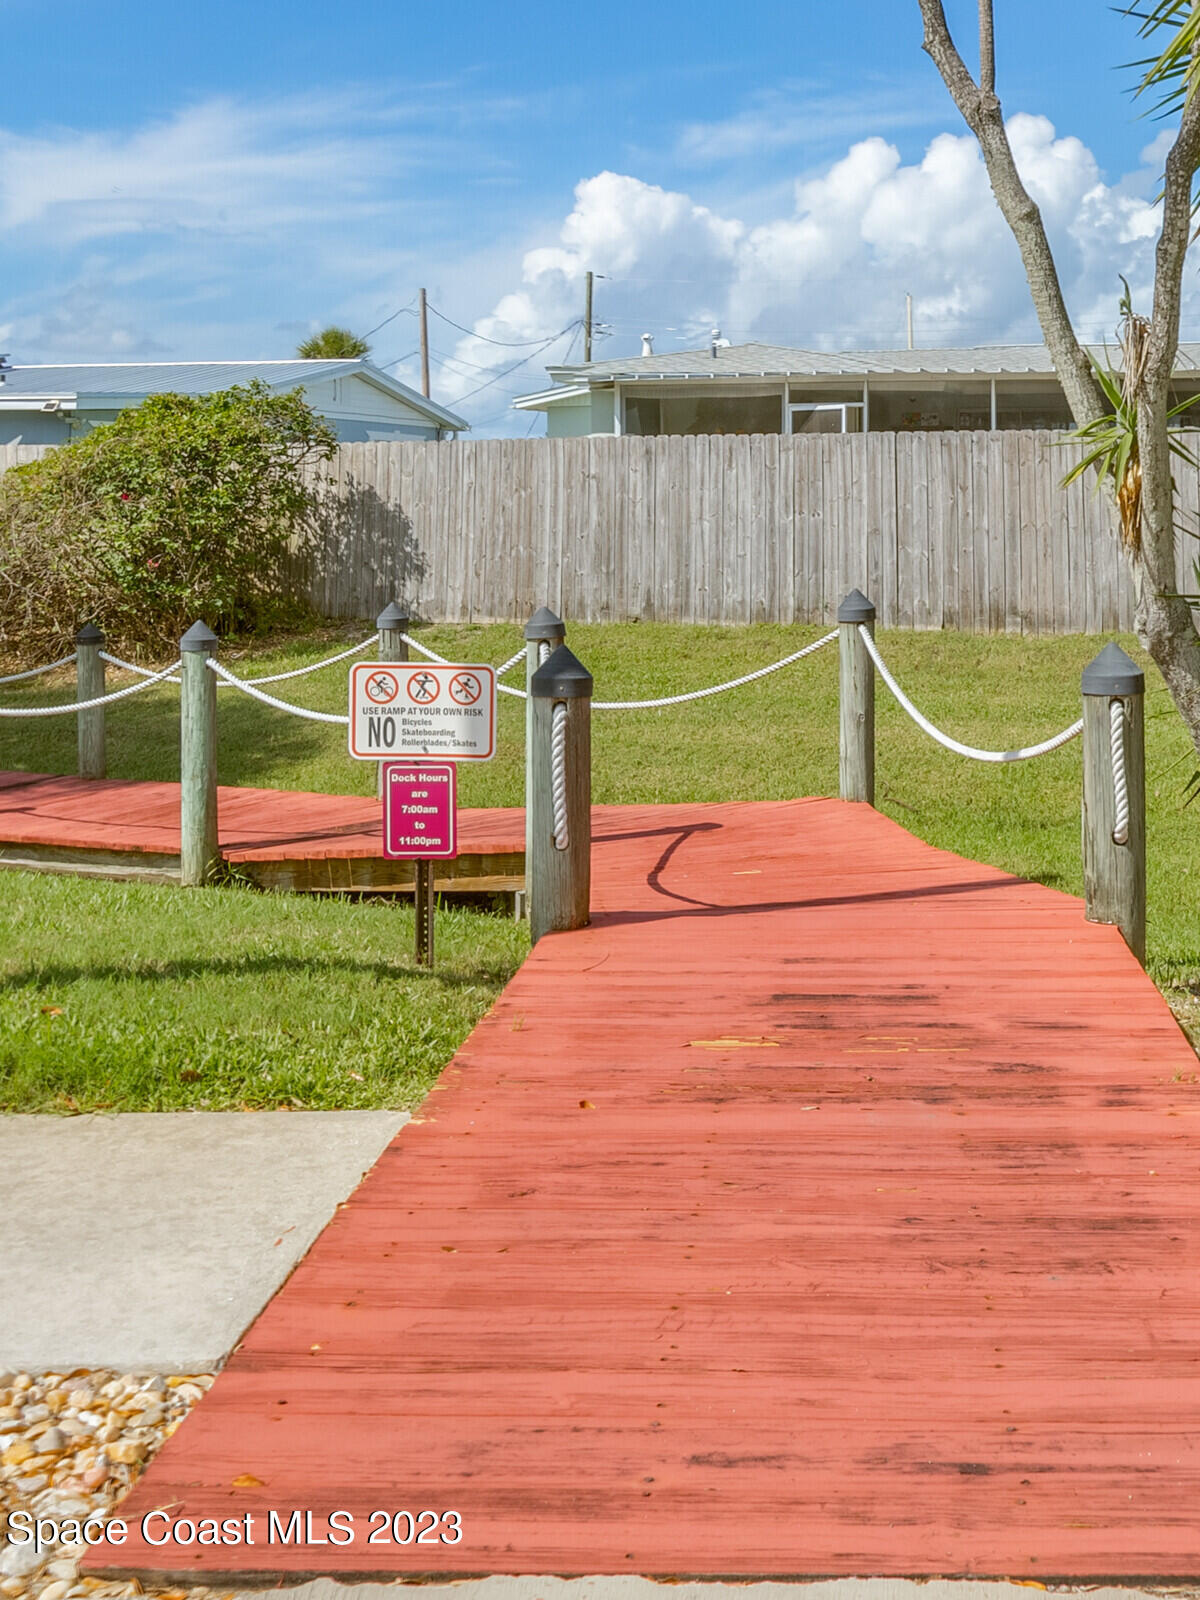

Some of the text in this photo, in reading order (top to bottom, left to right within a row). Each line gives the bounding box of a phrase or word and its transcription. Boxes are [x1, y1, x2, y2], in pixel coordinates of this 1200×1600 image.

[362, 706, 484, 717] USE RAMP AT YOUR OWN RISK
[401, 718, 433, 726] Bicycles
[368, 716, 396, 748] NO
[401, 728, 456, 738] Skateboarding
[391, 773, 448, 782] Dock Hours
[401, 805, 438, 814] 7:00am
[414, 821, 425, 829] to
[399, 837, 442, 847] 11:00pm
